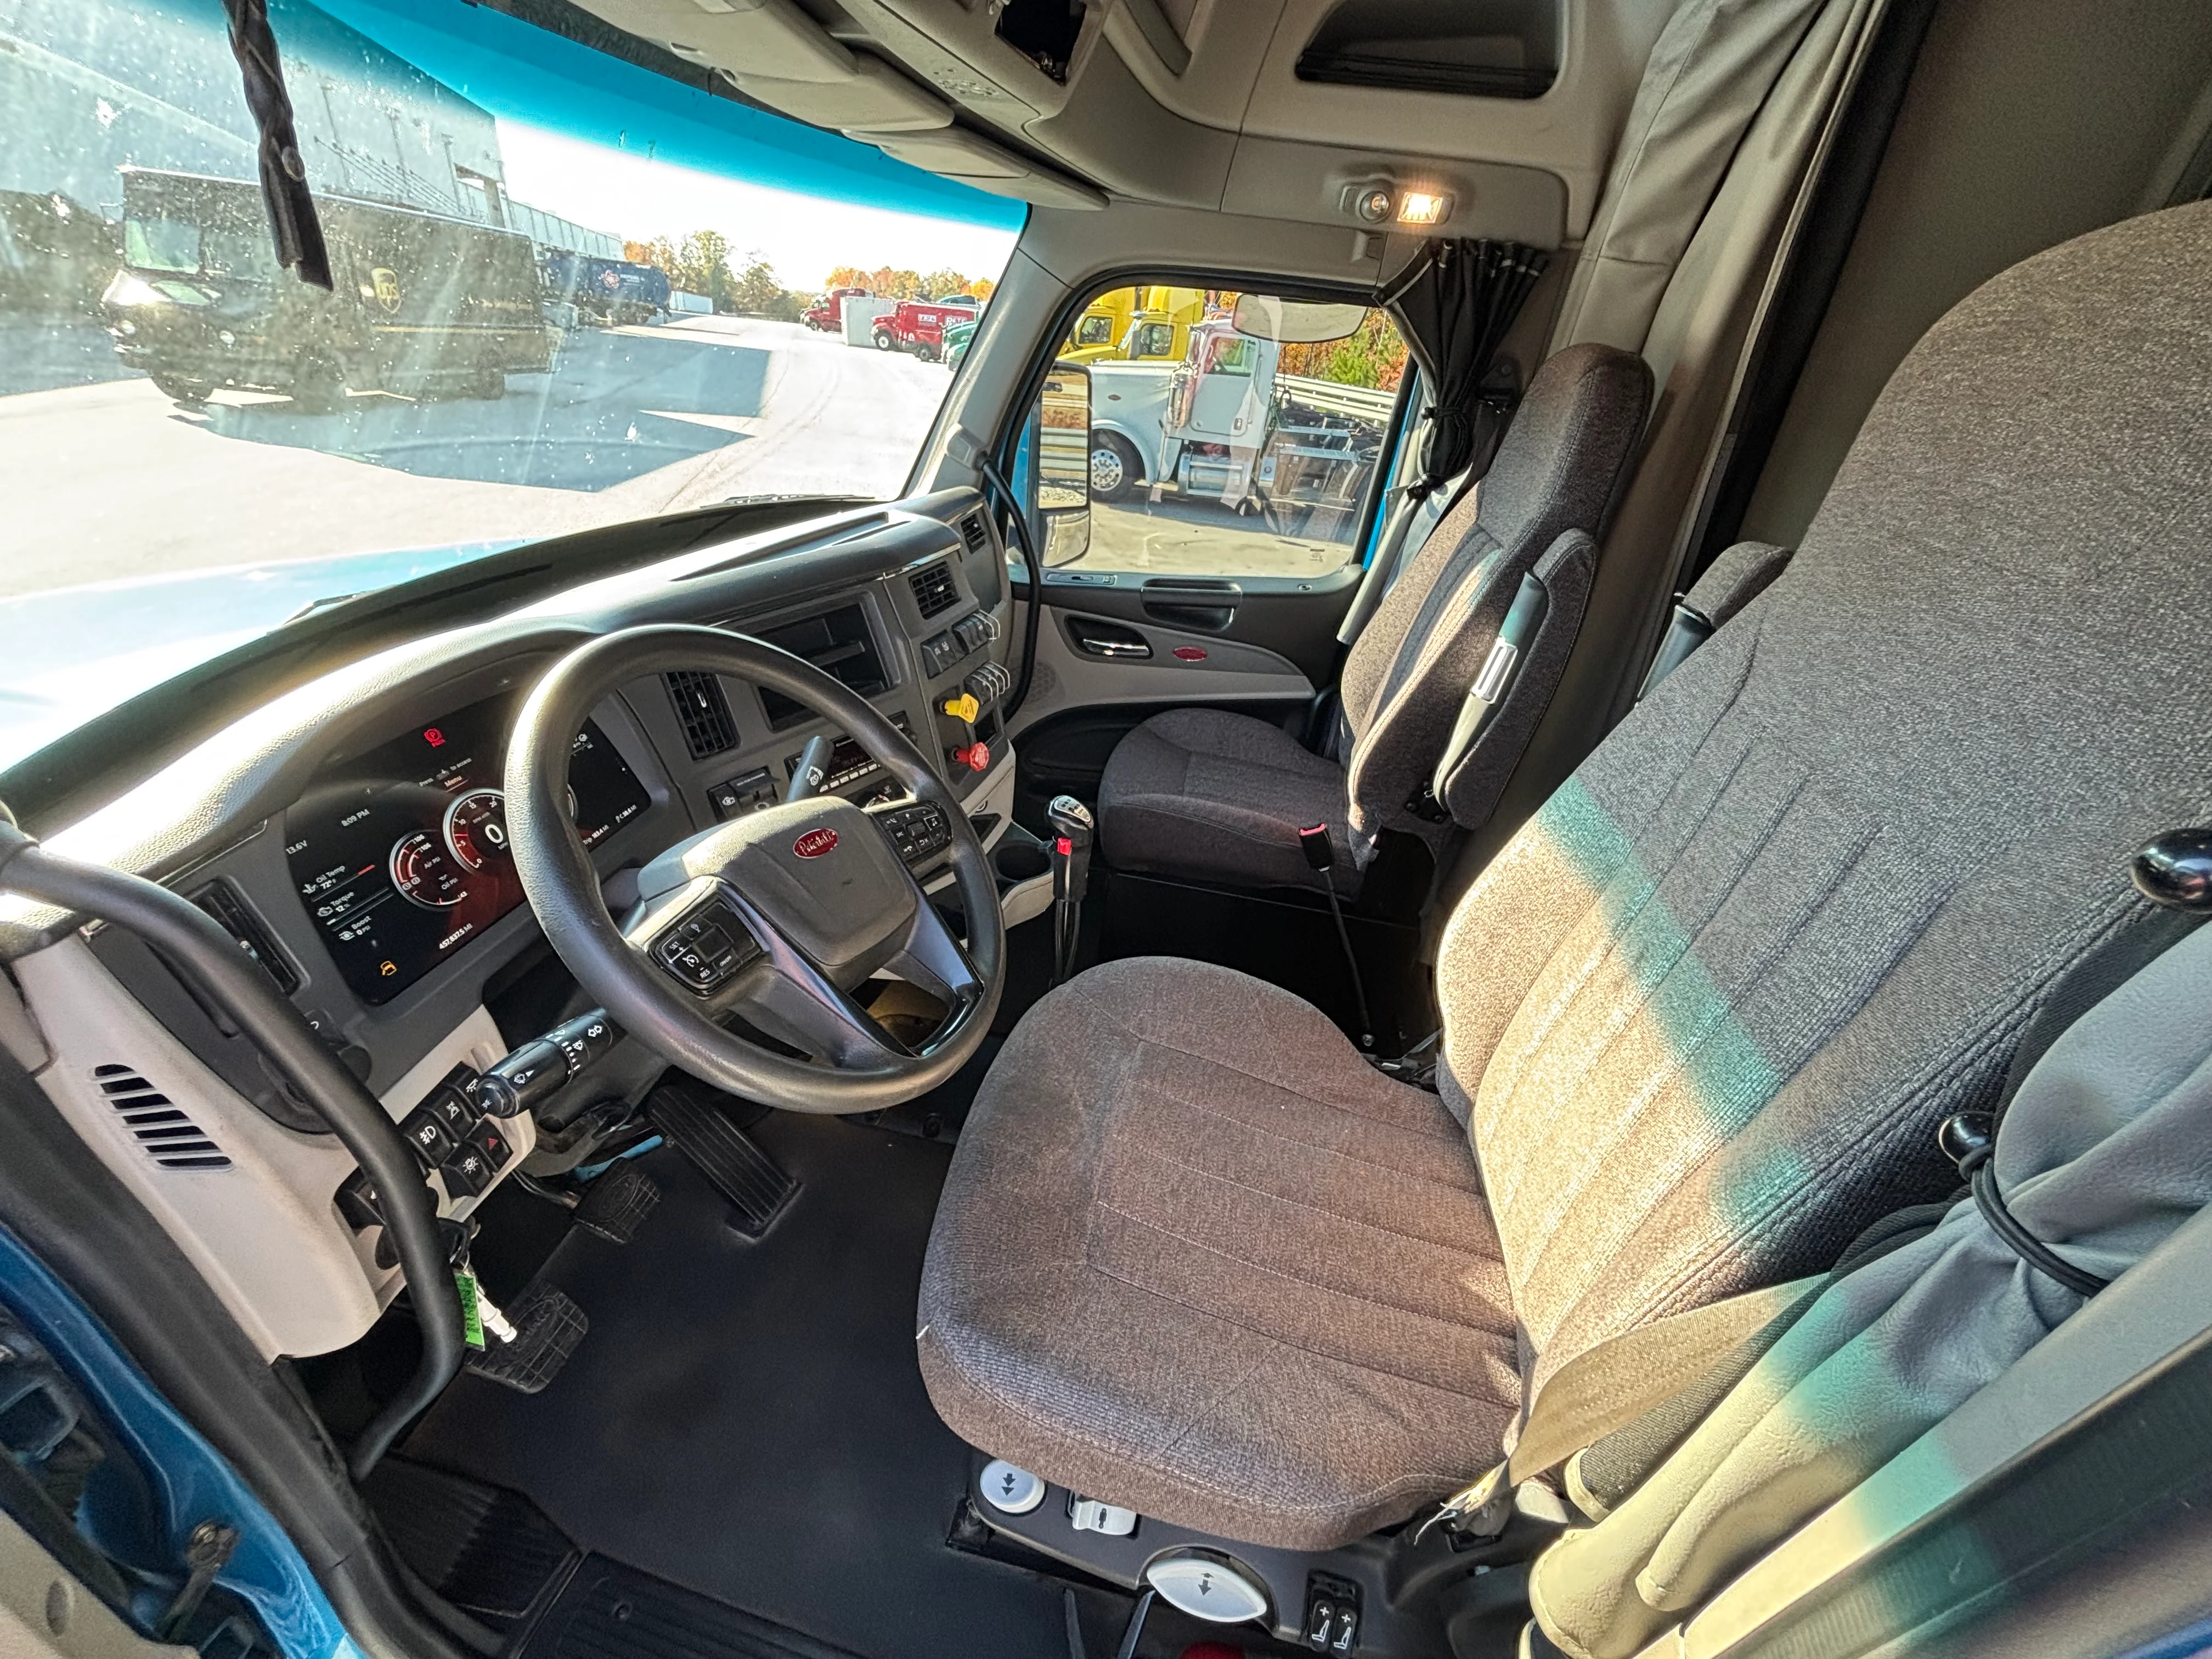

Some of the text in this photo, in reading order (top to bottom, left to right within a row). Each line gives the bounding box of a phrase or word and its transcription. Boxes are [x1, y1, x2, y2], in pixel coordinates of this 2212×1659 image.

[444, 775, 462, 787] Menu
[357, 809, 370, 819] PM
[485, 824, 504, 844] 0
[286, 840, 308, 855] 13.6V
[316, 866, 346, 883] Oil Temp
[330, 892, 355, 906] Torque
[351, 916, 372, 929] Boost
[463, 923, 473, 932] MI
[669, 941, 680, 951] SET
[699, 969, 710, 979] RES
